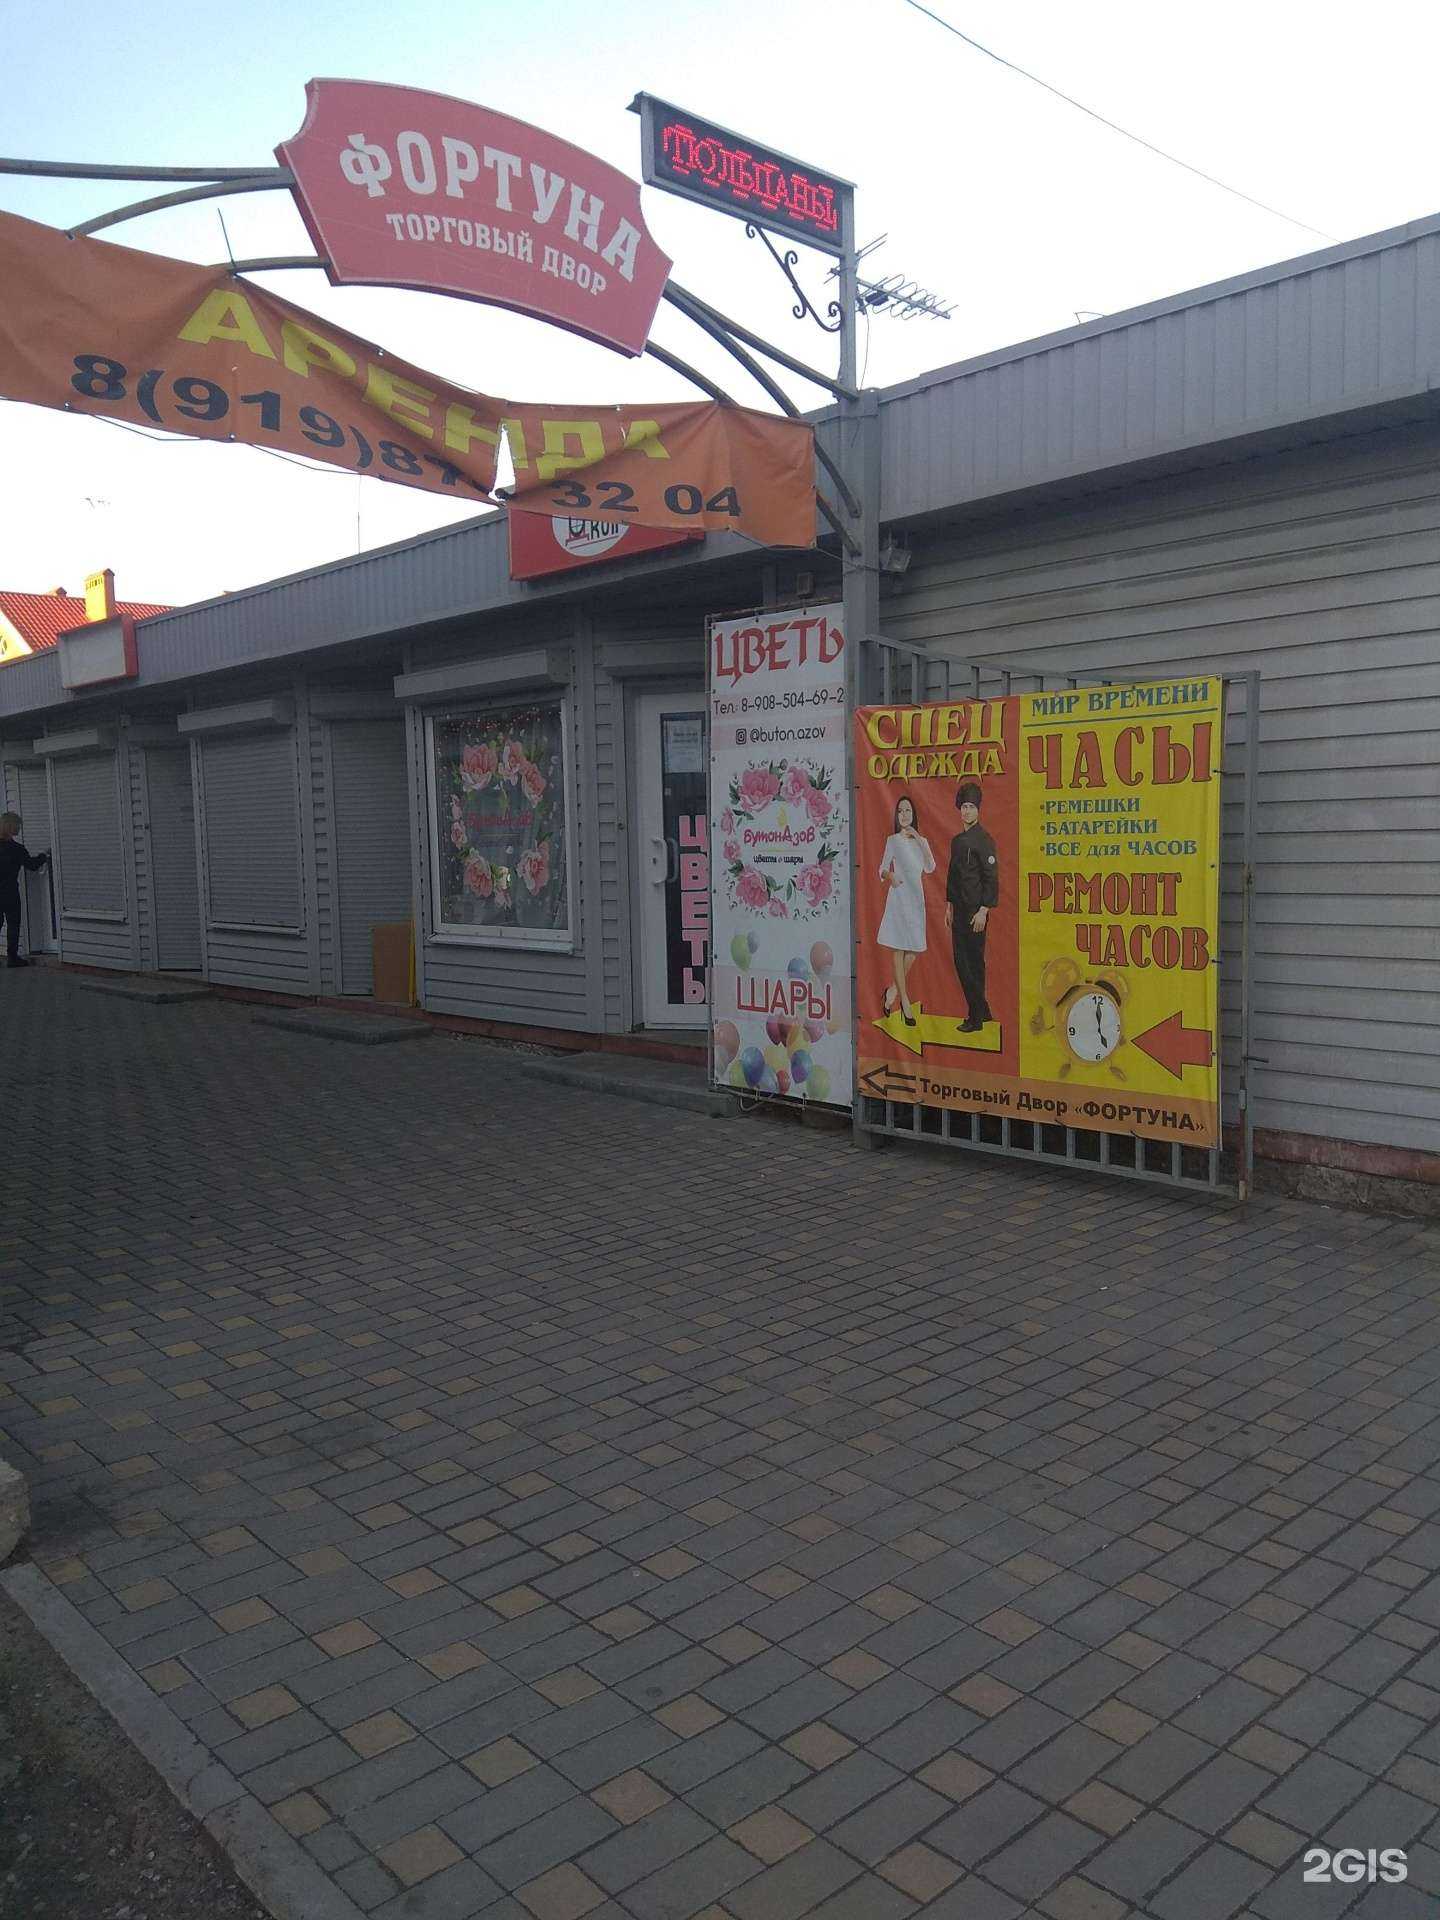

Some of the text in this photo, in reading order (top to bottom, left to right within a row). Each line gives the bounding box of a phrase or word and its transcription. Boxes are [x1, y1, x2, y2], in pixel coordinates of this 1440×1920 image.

[339, 131, 643, 283] ФОРТУНА
[386, 212, 608, 296] ТОРГОВЫЙ ДВОР
[177, 288, 672, 480] АРЕНДА
[551, 480, 640, 513] 32
[663, 483, 742, 517] 04
[1032, 682, 1210, 717] МИР ВРЕМЕНИ
[750, 725, 827, 743] @buton.azov
[866, 700, 1007, 753] СПЕЦ
[867, 748, 1007, 784] ОДЕЖДА
[1027, 721, 1214, 790] ЧАСЫ
[1045, 797, 1141, 815] РЕМЕШКИ
[1045, 817, 1159, 836] БАТАРЕЙКИ
[1045, 839, 1198, 859] ВСЕ для ЧАСОВ
[1027, 872, 1183, 917] РЕМОНТ
[1075, 923, 1211, 972] ЧАСОВ
[736, 976, 831, 1021] ШАРЫ
[1091, 995, 1104, 1006] 12
[1068, 1026, 1076, 1036] 9
[919, 1077, 1206, 1133] Торговый Двор «ФОРТУНА»
